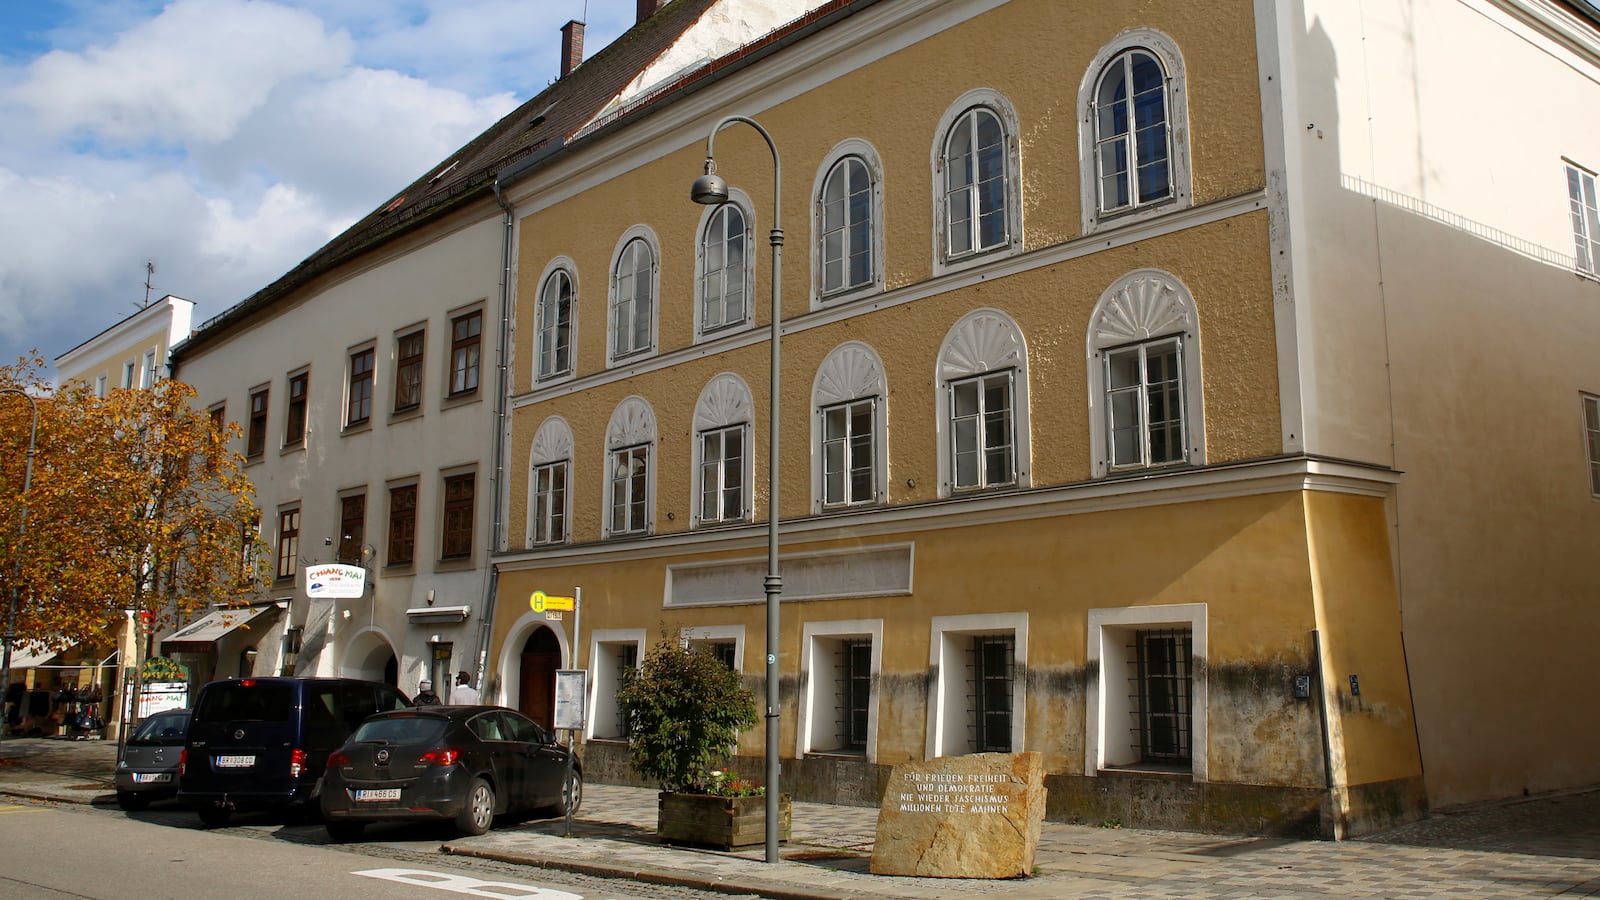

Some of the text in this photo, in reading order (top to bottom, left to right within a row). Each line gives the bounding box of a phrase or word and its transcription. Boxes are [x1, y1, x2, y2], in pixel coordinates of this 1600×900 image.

[309, 568, 344, 580] CHIANG
[344, 569, 362, 580] MAI
[534, 595, 543, 609] H
[904, 771, 1007, 783] FÜR FRIEDEN FREIHEIT
[917, 783, 995, 793] UND DEMOKRATIE
[388, 790, 397, 798] CS
[900, 793, 1009, 803] NIE WIEDER FASCHISMUS
[899, 804, 1009, 814] MILLIONEN TOTE MAHNEN
